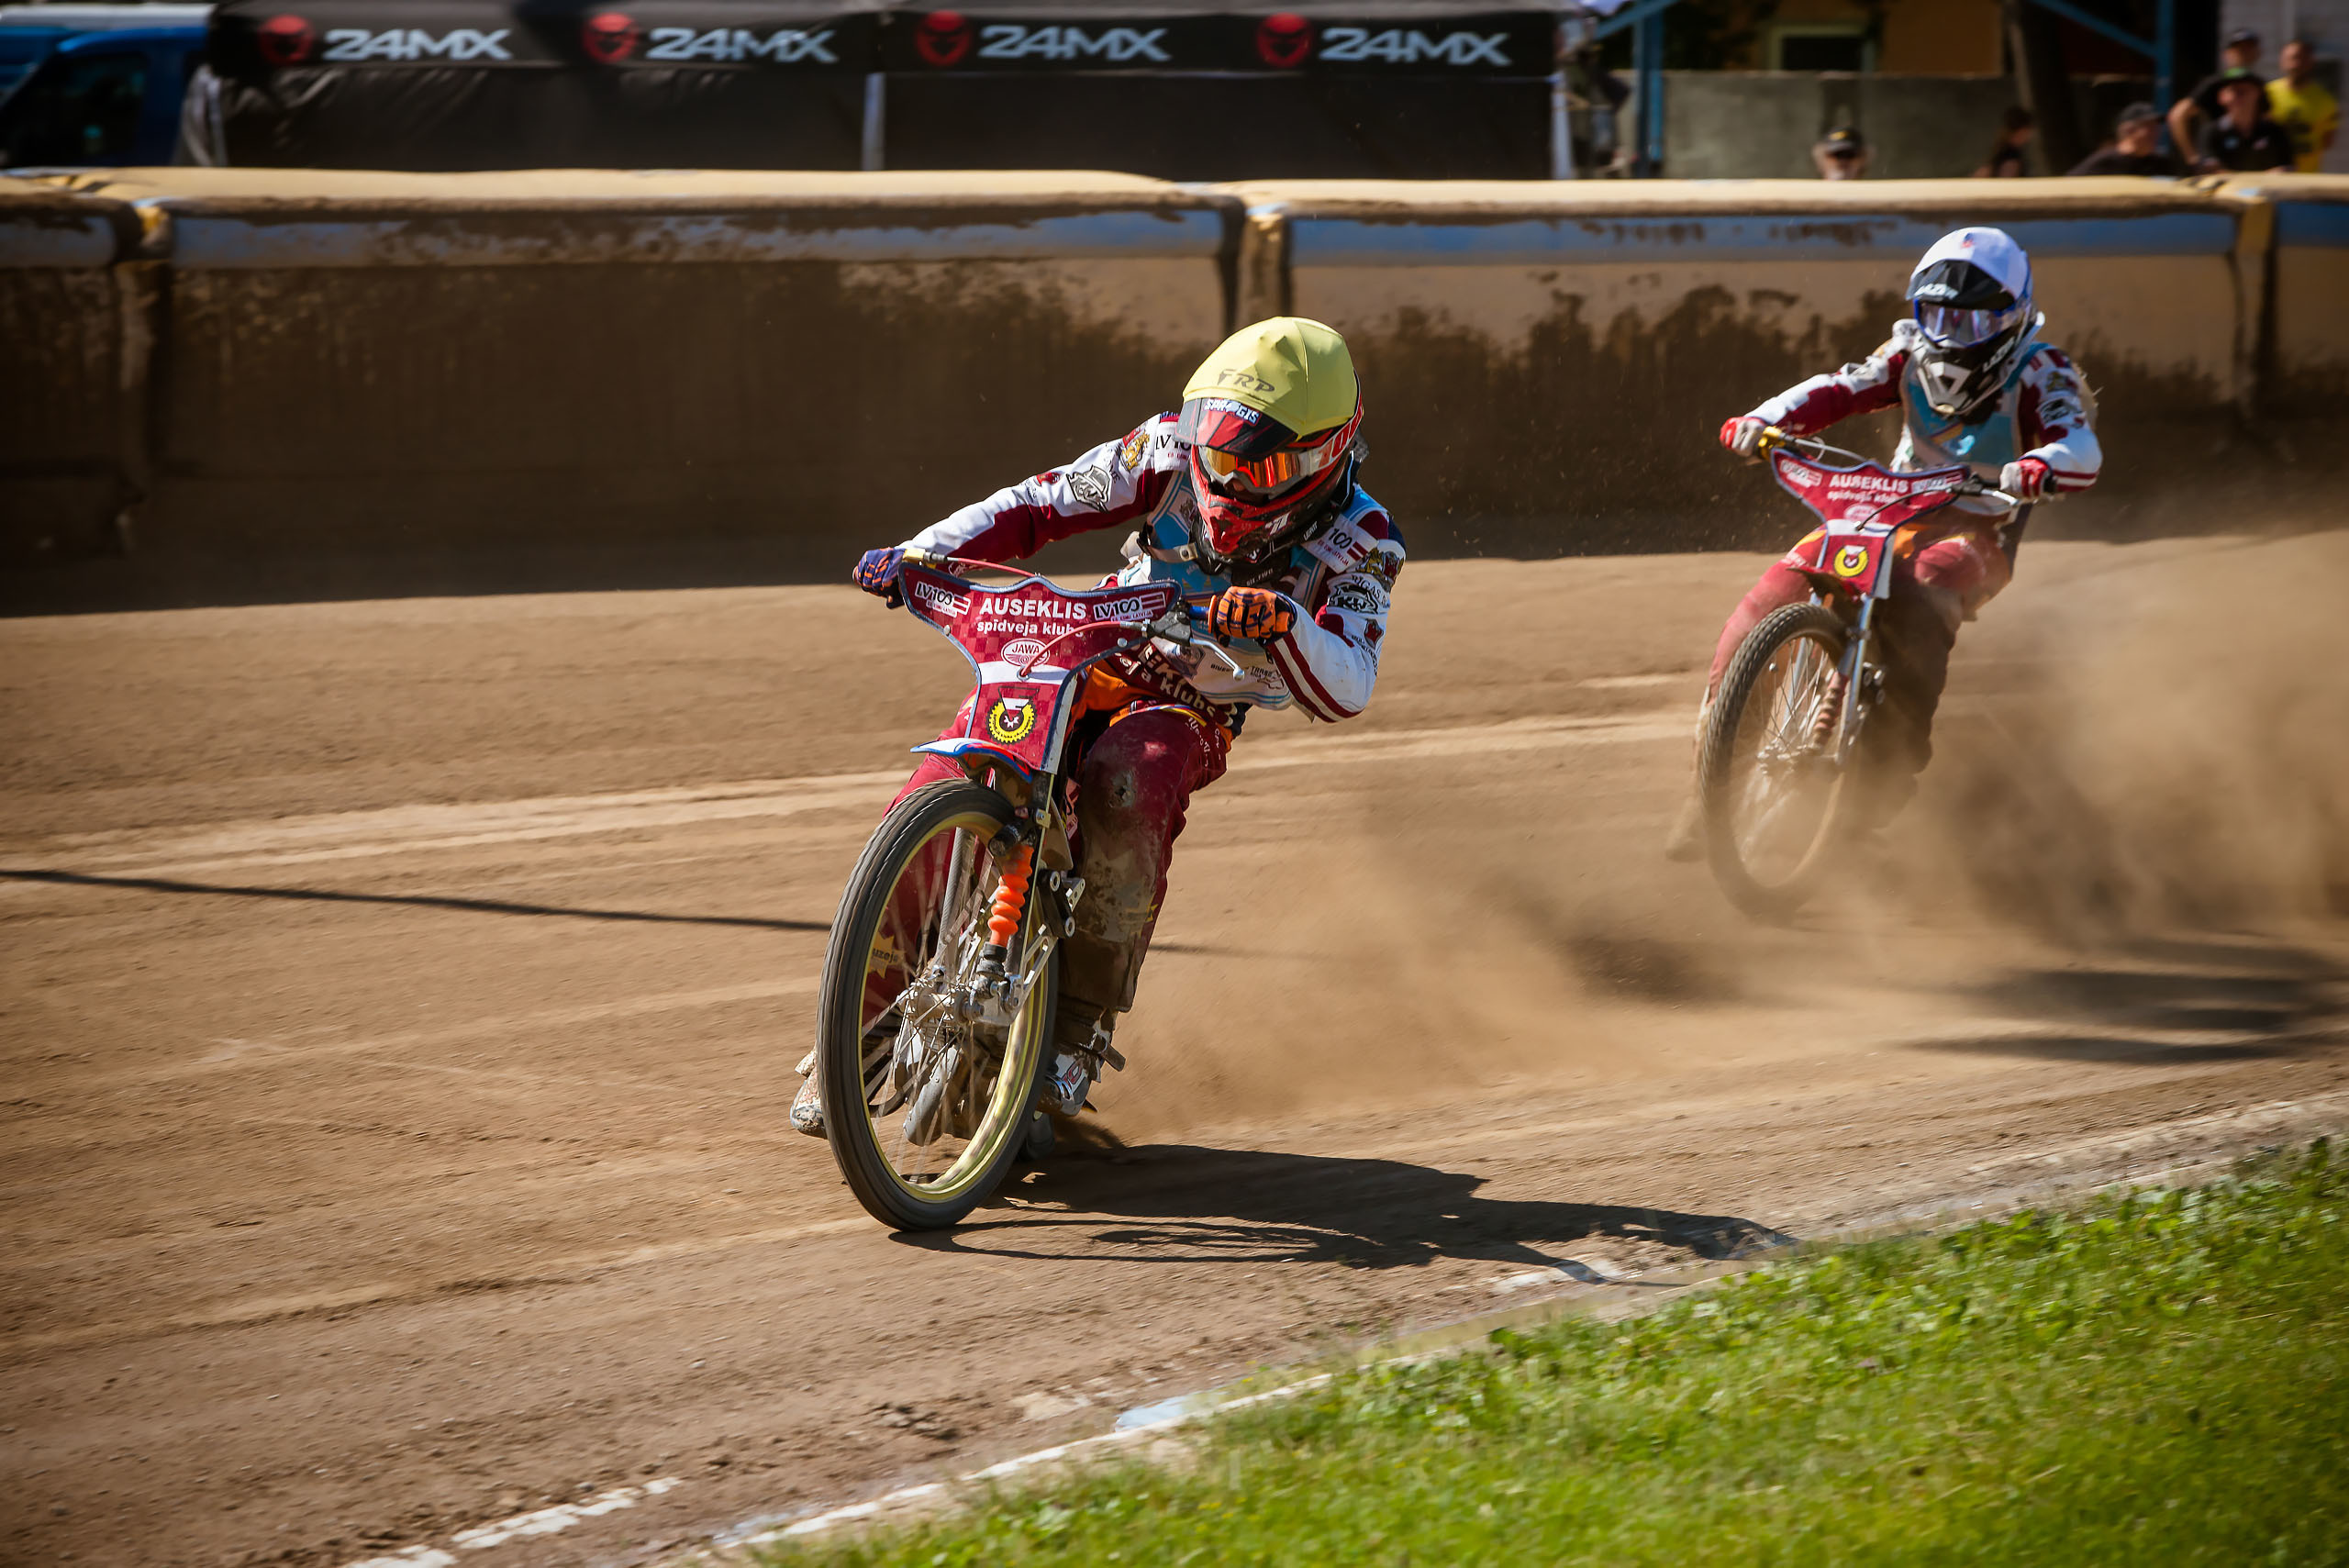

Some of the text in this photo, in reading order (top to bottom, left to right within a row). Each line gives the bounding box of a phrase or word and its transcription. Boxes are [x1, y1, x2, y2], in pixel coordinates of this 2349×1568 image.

[323, 29, 512, 60] 24MX
[646, 29, 838, 62] 24MX
[979, 26, 1172, 61] 24MX
[1319, 28, 1511, 65] 24MX
[1218, 369, 1275, 392] FRP
[1829, 474, 1909, 494] AUSEKLIS
[979, 597, 1086, 620] AUSEKLIS
[976, 619, 1038, 637] spīdveja
[1011, 643, 1040, 654] JAWA
